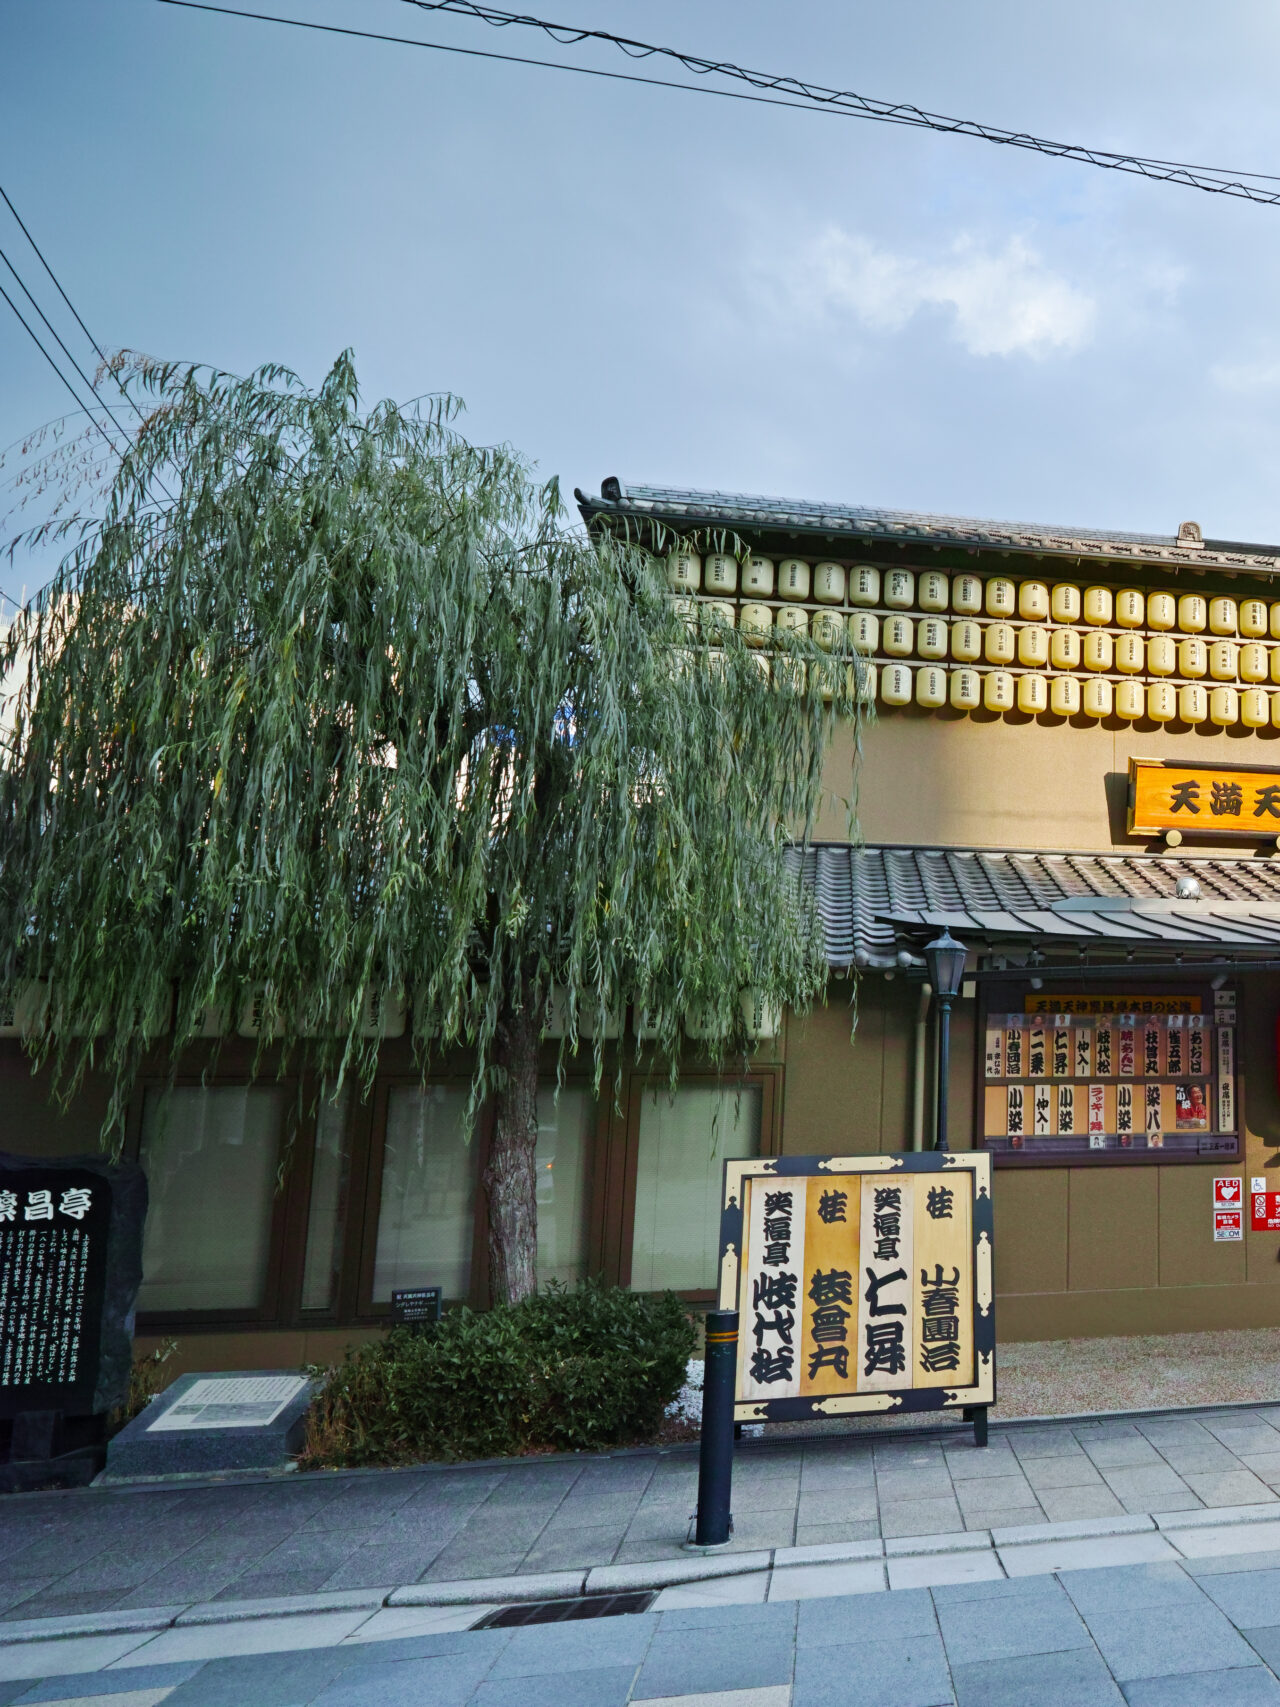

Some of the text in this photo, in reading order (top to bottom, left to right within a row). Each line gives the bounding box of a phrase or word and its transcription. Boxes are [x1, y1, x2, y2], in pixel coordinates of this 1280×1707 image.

[1009, 1087, 1023, 1132] 小染
[1060, 1087, 1073, 1131] 小染
[1118, 1086, 1132, 1131] 小染
[1146, 1086, 1161, 1131] 染八
[817, 1189, 848, 1224] 桂
[873, 1187, 902, 1261] 笑福亭
[925, 1186, 955, 1219] 桂
[762, 1190, 793, 1267] 笑福亭
[749, 1271, 798, 1385] 岐代松
[864, 1267, 908, 1378] 仁昇
[920, 1264, 961, 1373] 小春團治
